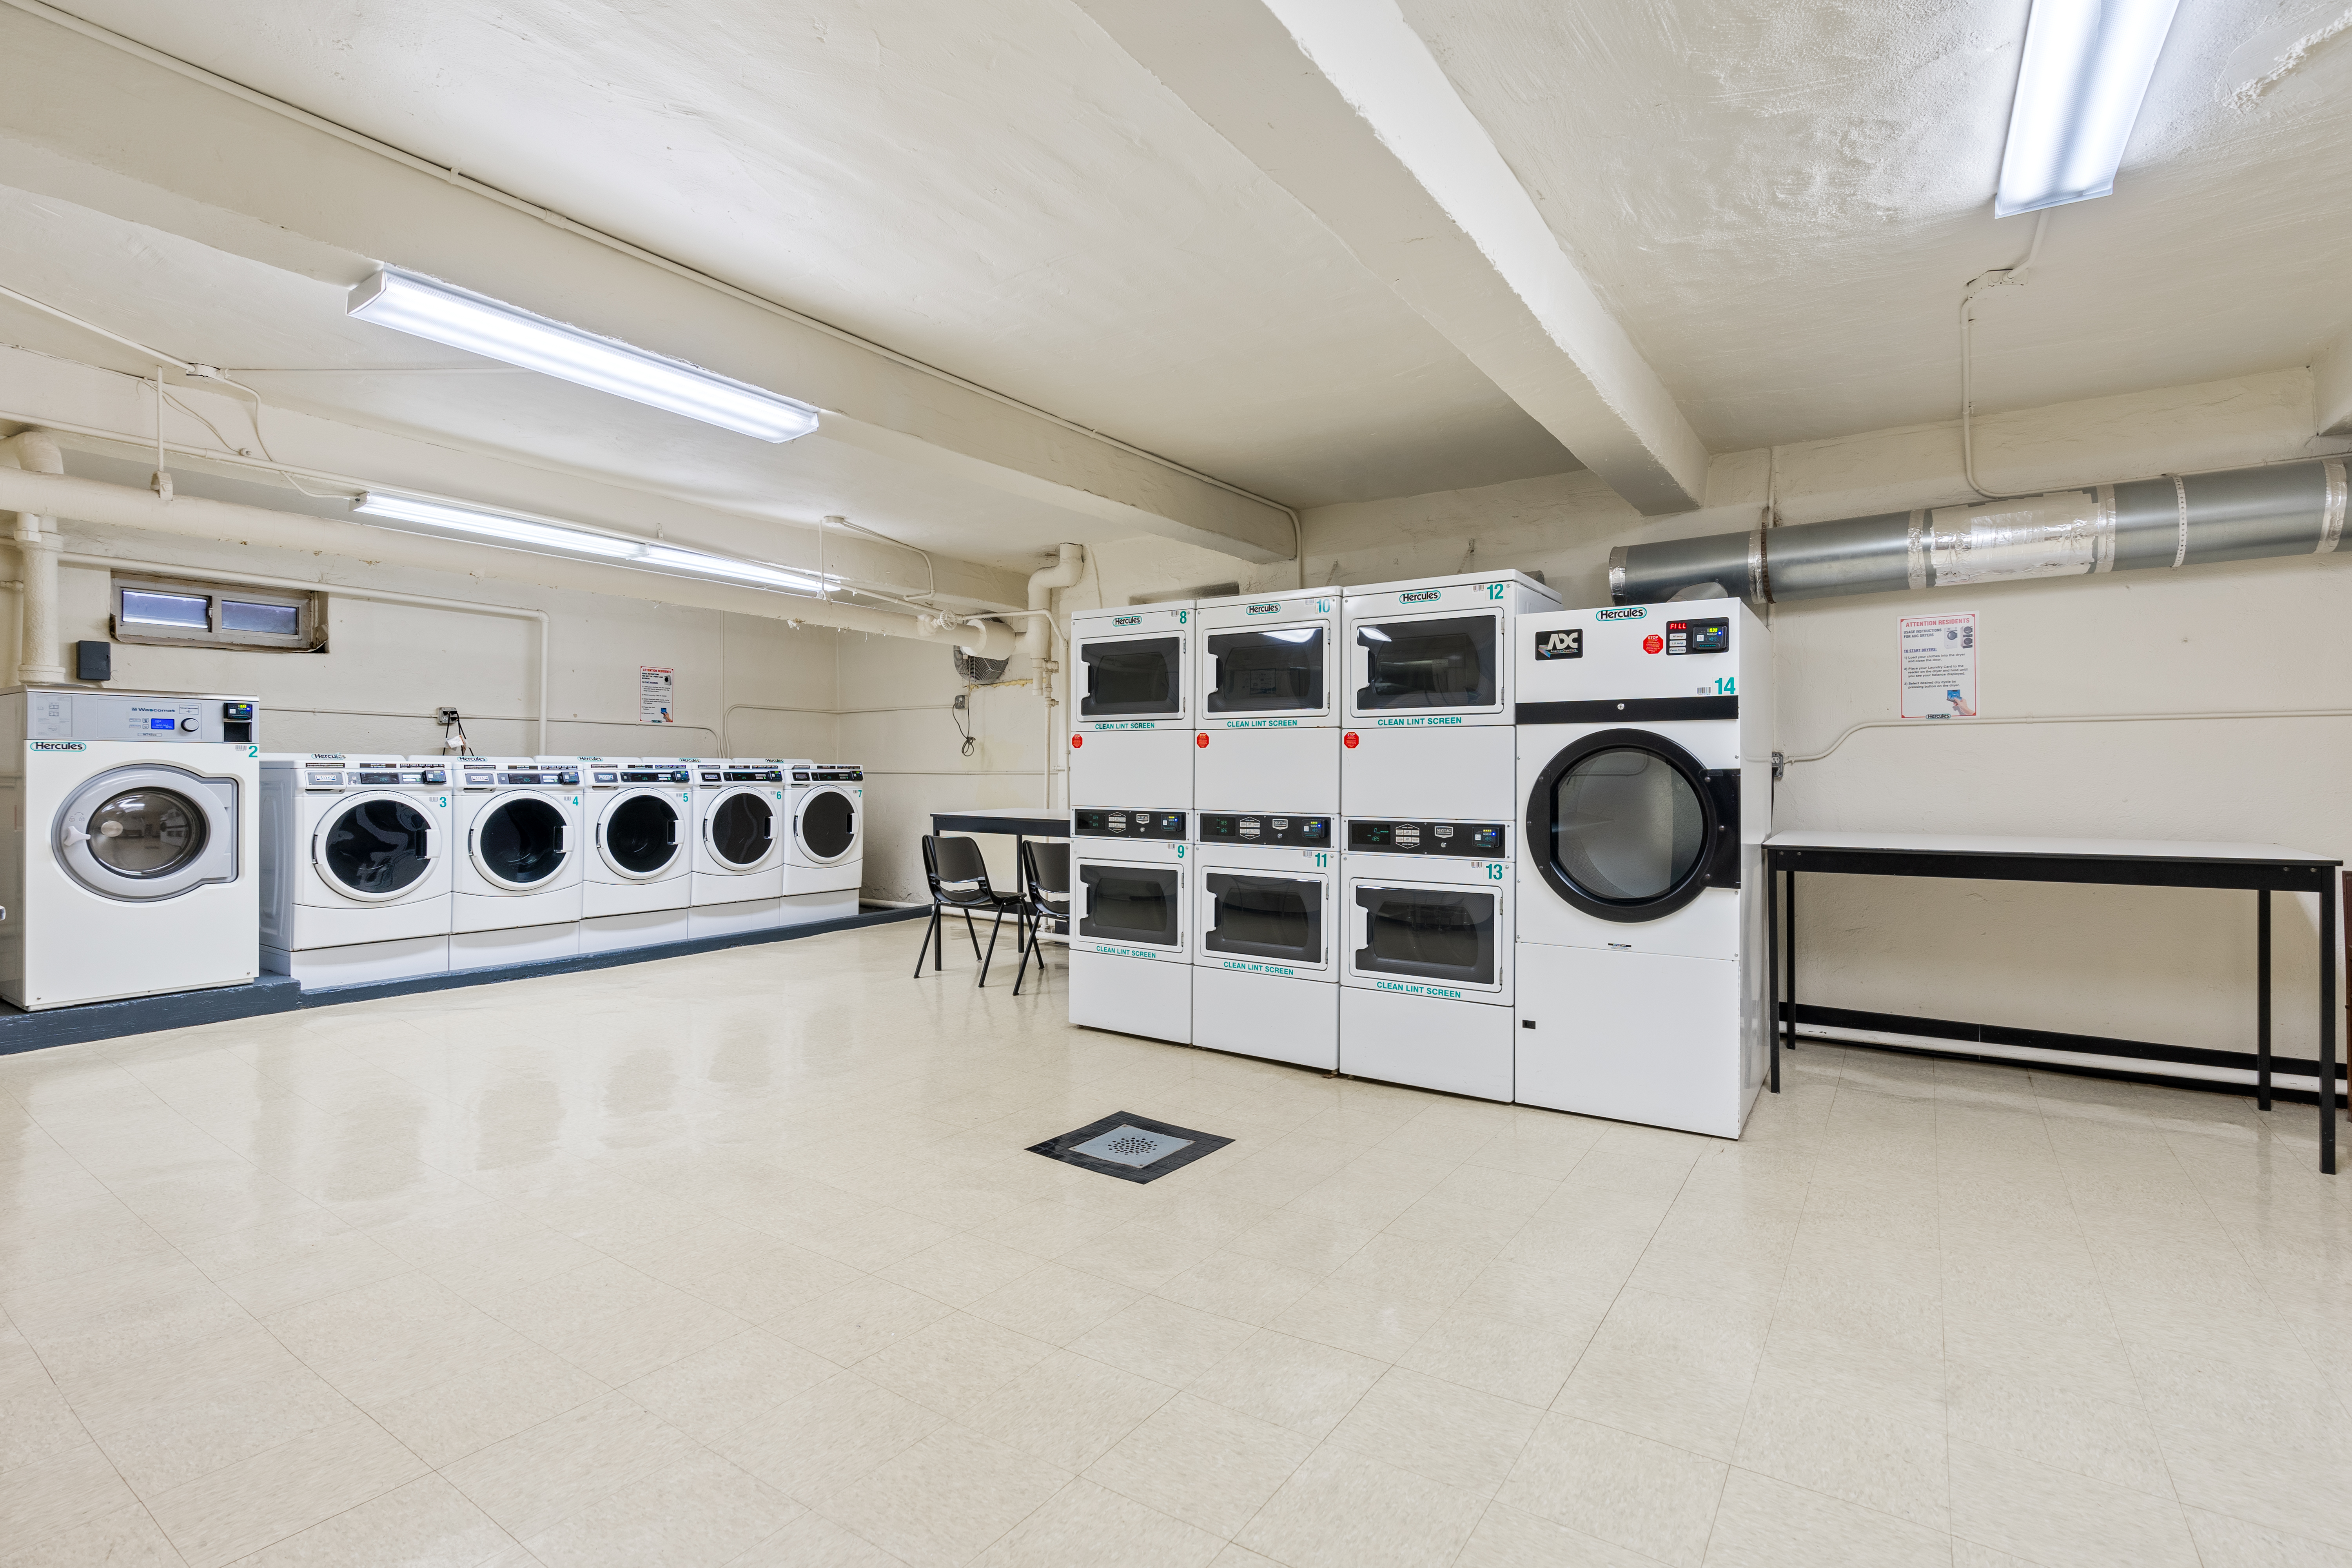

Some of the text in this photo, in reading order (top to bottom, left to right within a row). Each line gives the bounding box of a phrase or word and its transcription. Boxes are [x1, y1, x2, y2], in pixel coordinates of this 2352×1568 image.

[1403, 592, 1438, 602] Hercules
[1487, 584, 1504, 600] 12
[1249, 604, 1278, 613] Hercules
[1317, 599, 1330, 613] 10
[1180, 611, 1187, 624] 8
[1600, 608, 1643, 619] Hercules
[1115, 617, 1140, 625] Hercules
[1547, 632, 1578, 650] ADC
[1715, 677, 1735, 695] 14
[249, 746, 258, 758] 2
[573, 796, 579, 806] 4
[683, 793, 688, 802] 5
[777, 791, 781, 799] 6
[439, 797, 446, 808] 3
[1178, 845, 1184, 858] 9
[1315, 853, 1327, 867] 11
[1486, 864, 1503, 880] 13
[1131, 950, 1156, 958] SCREEN
[1223, 962, 1246, 970] CLEAN
[1265, 966, 1294, 975] SCREEN
[1377, 982, 1461, 998] CLEAN LINT SCREEN
